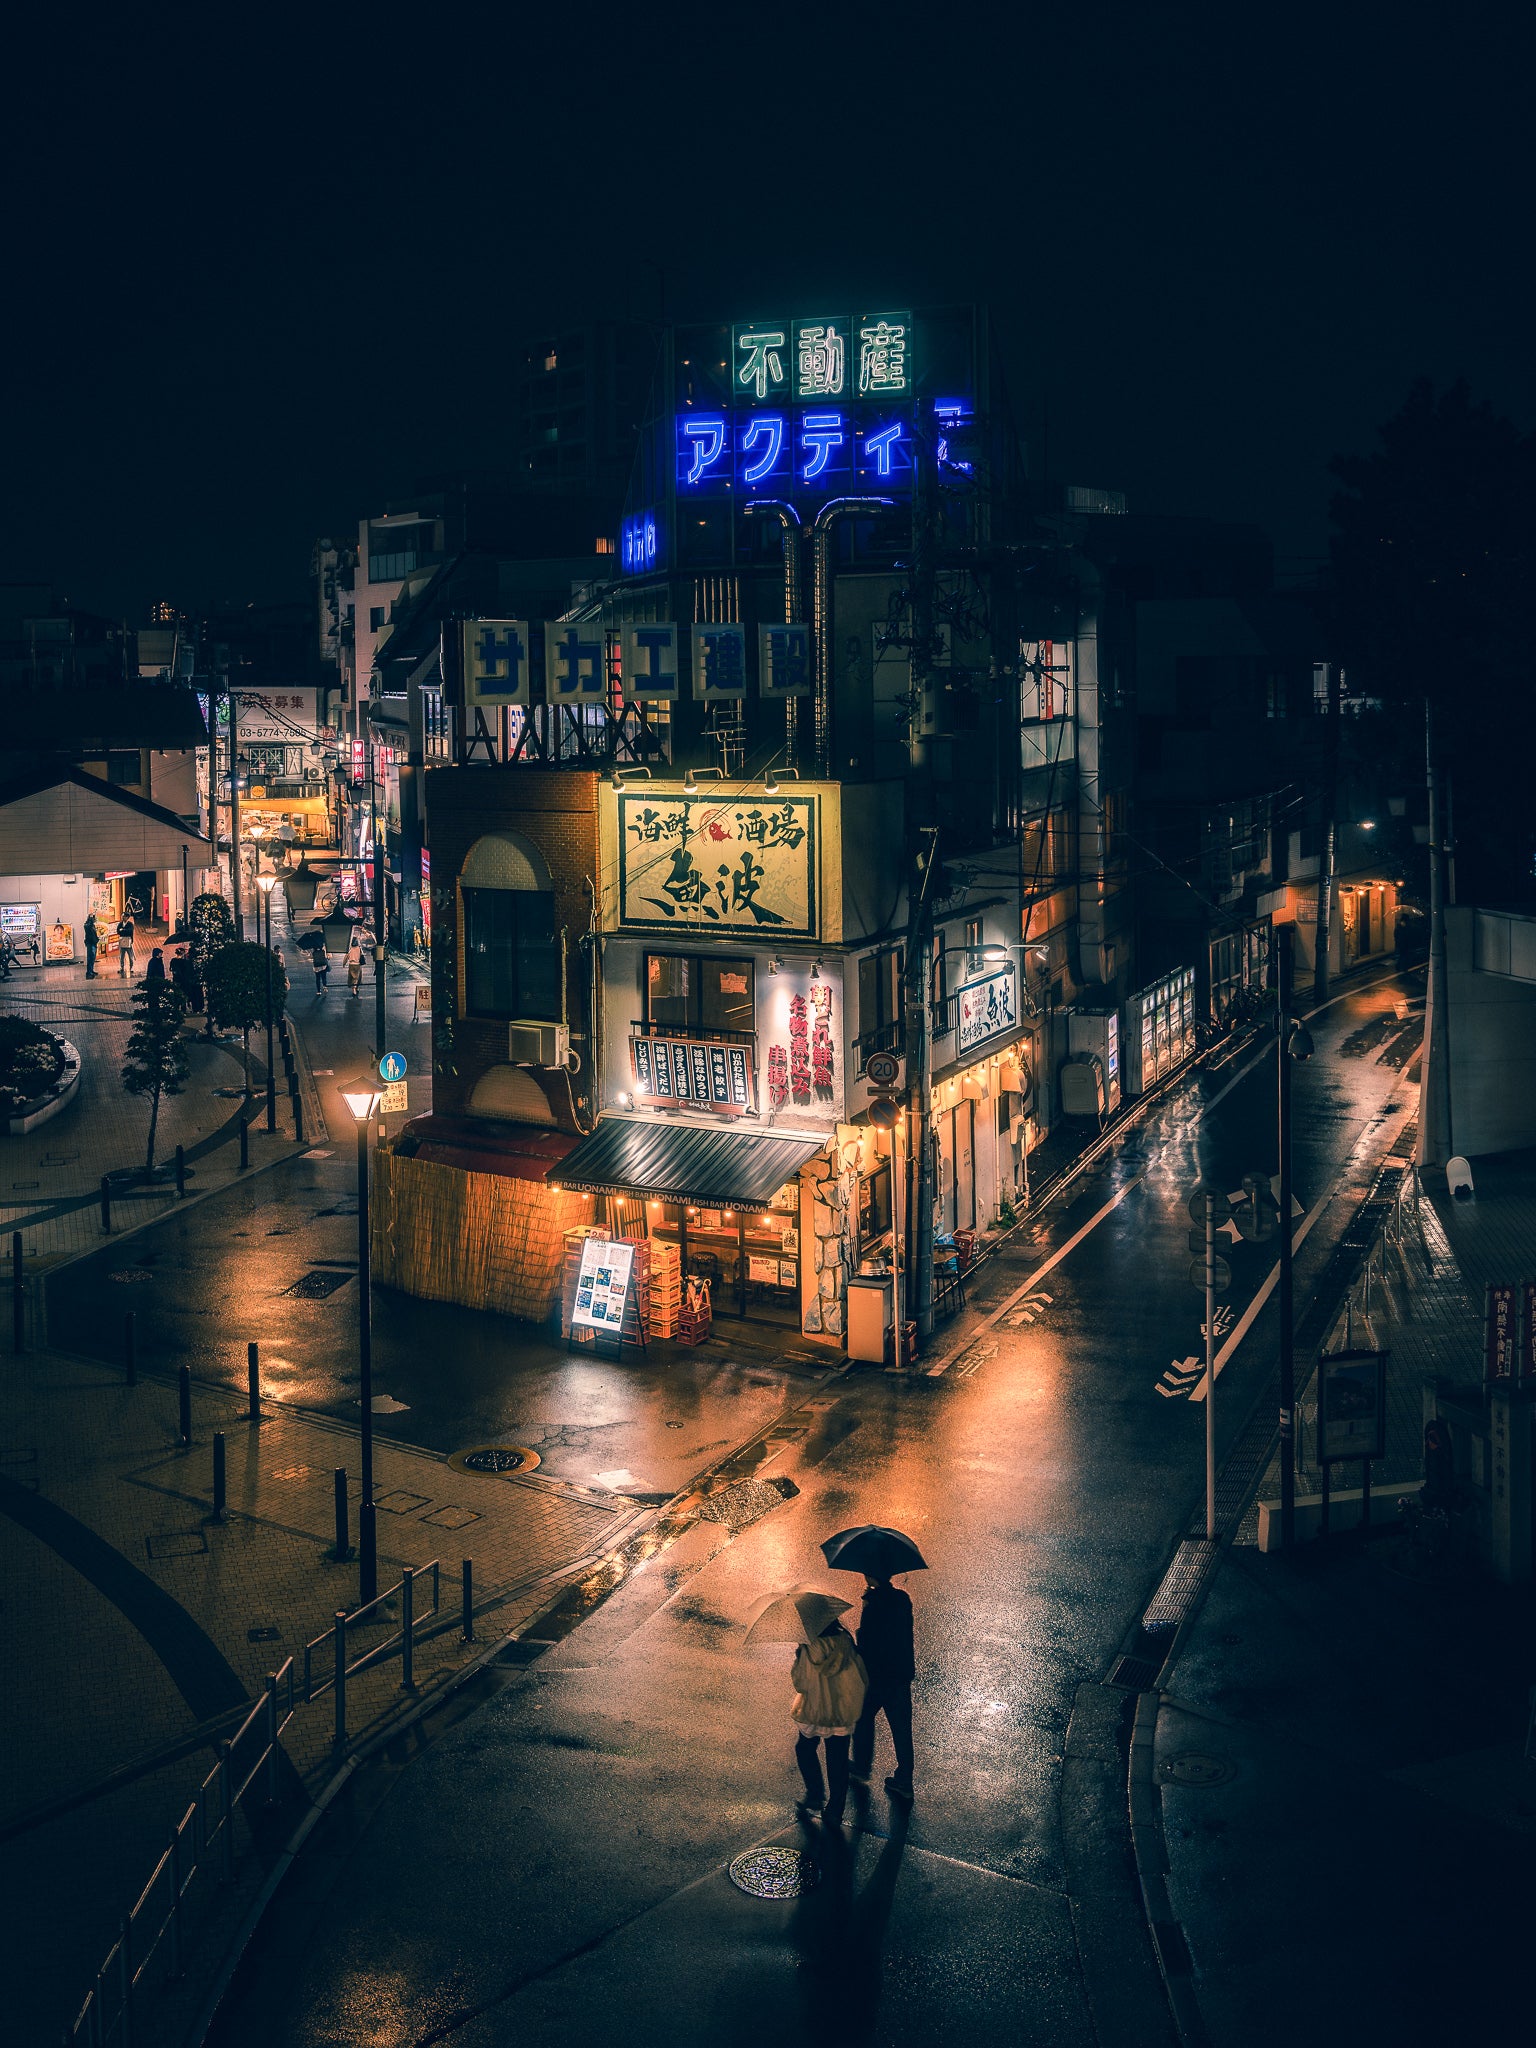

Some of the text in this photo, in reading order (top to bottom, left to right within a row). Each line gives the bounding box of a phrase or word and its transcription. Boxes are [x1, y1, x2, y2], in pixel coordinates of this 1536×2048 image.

[739, 322, 905, 398] 不動産
[638, 848, 794, 925] 魚波
[980, 978, 1016, 1032] 魚波
[789, 994, 811, 1097] 名物煮込み
[874, 1062, 892, 1076] 20
[768, 1044, 788, 1105] 串揚げ
[563, 1181, 577, 1190] BAR
[577, 1183, 617, 1195] UONAMI
[634, 1191, 649, 1199] BAR
[649, 1192, 691, 1205] UONAMI
[693, 1198, 767, 1214] FISH BAR UONAMI
